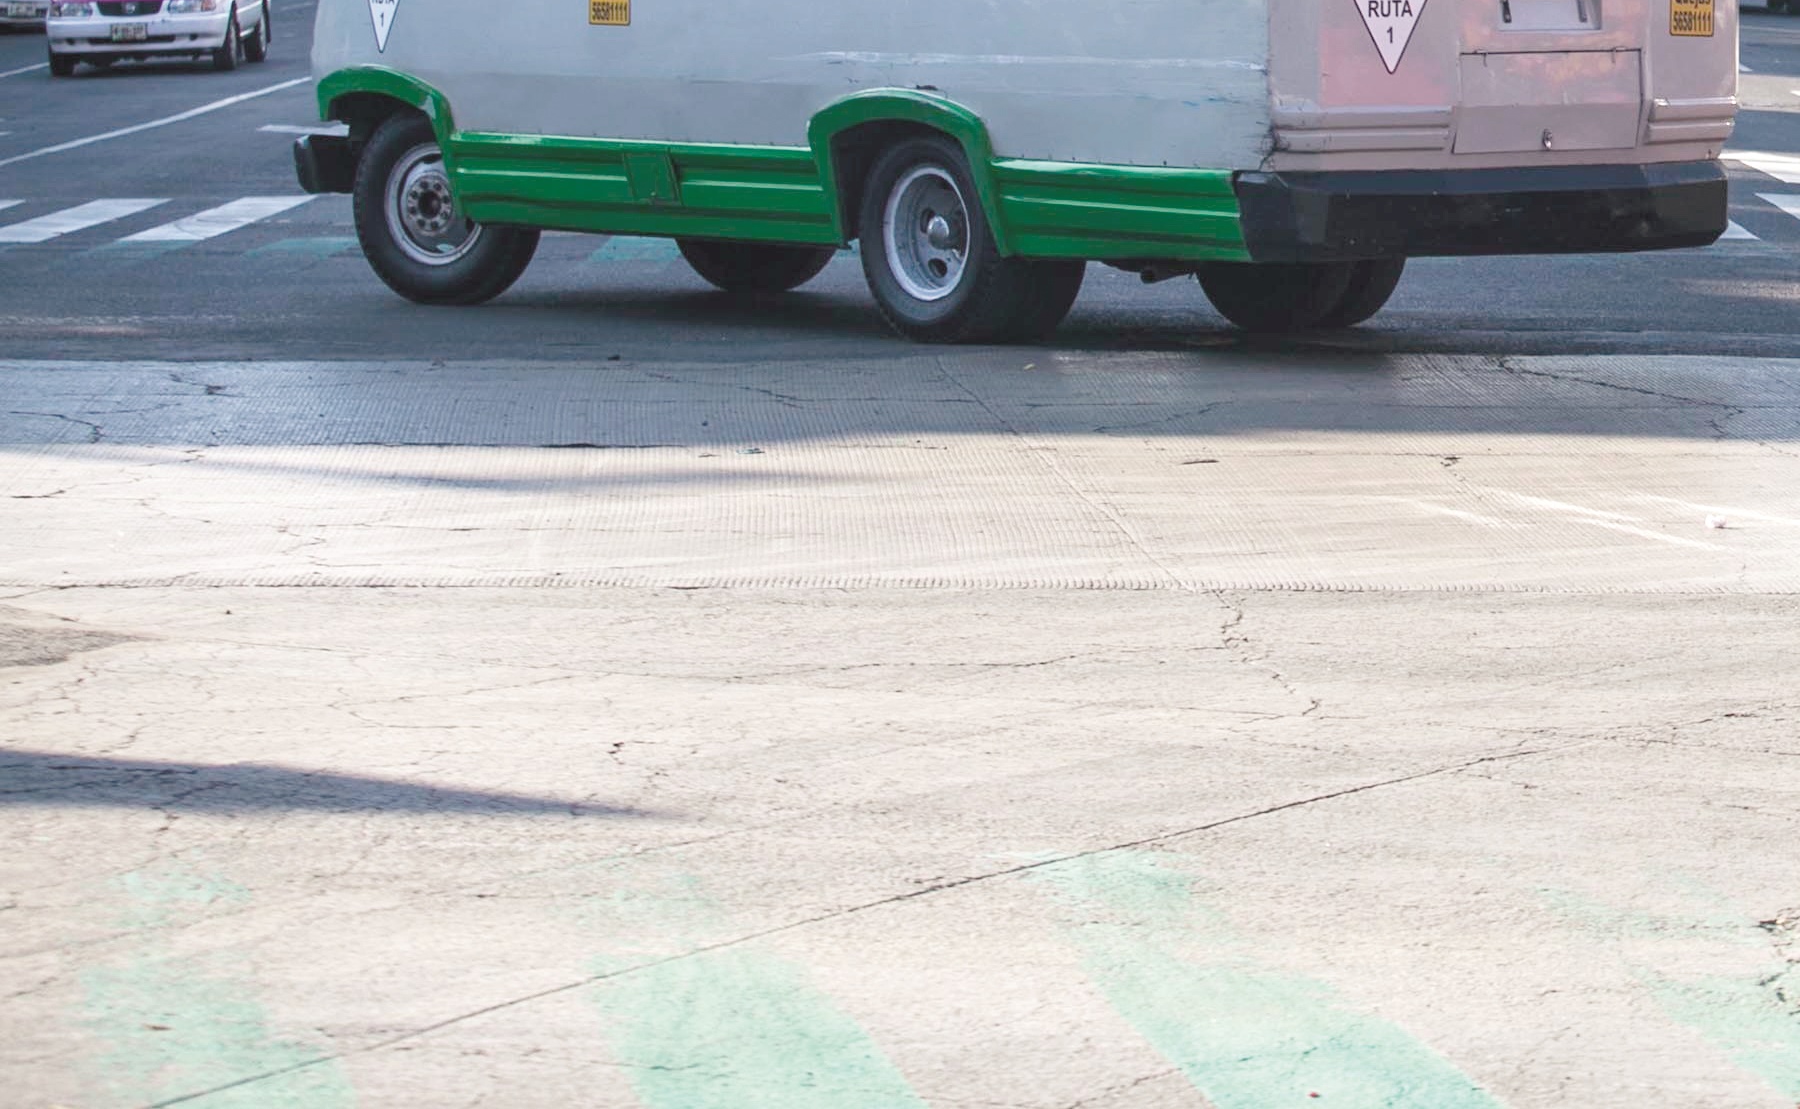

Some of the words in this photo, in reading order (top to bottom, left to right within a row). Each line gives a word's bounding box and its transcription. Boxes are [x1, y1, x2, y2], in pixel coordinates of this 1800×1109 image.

[1368, 0, 1413, 18] RUTA
[380, 12, 385, 27] 1
[1386, 26, 1393, 44] 1
